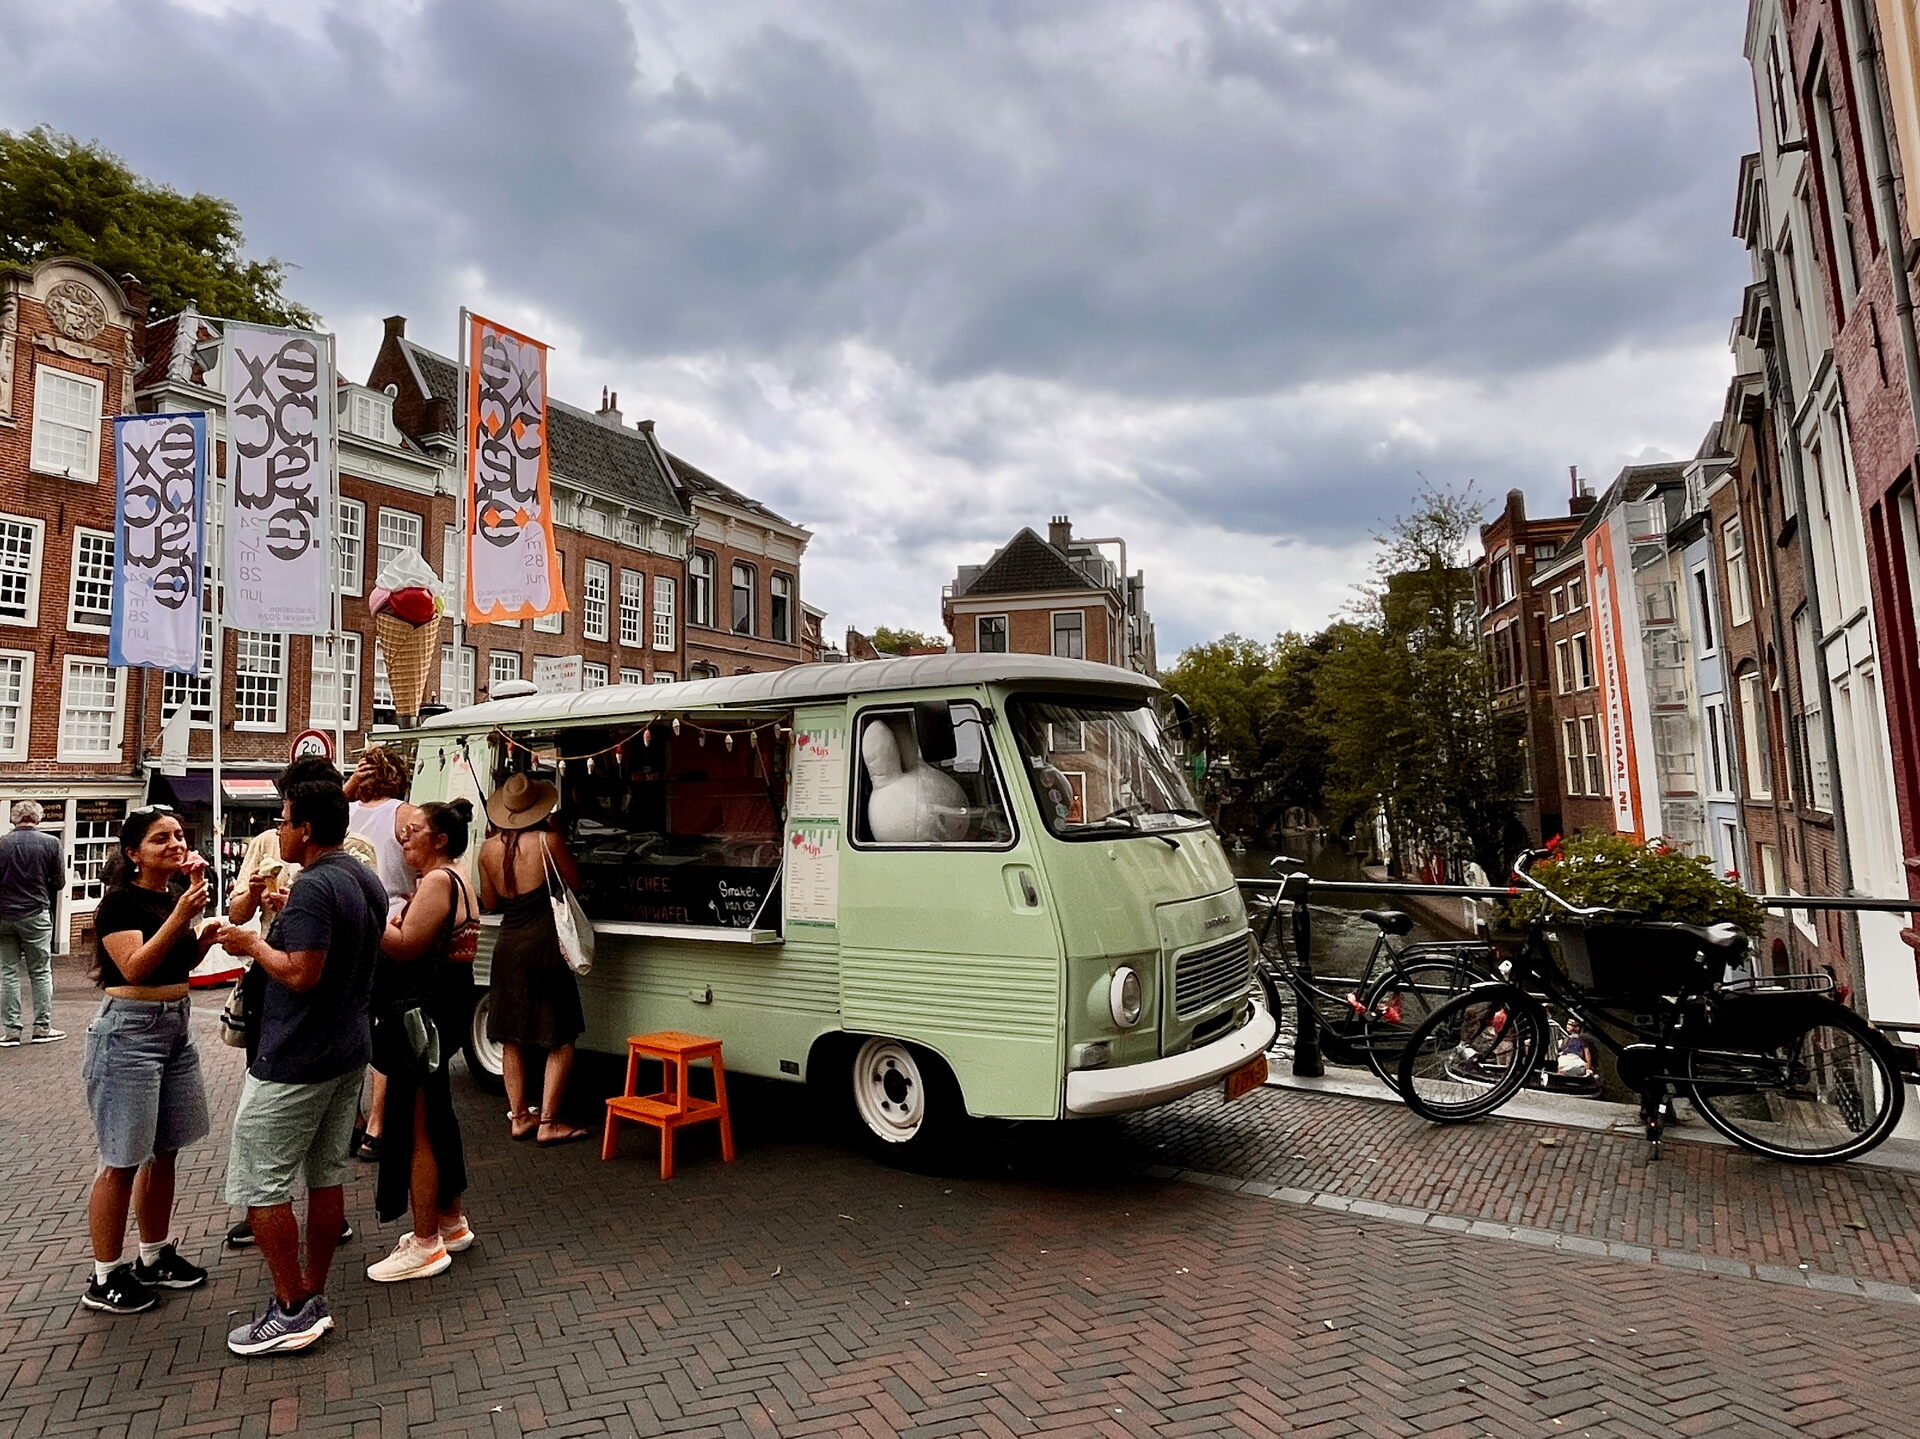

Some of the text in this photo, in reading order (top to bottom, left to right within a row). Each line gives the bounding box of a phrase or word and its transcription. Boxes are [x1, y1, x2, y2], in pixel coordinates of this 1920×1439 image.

[525, 554, 544, 568] 28
[525, 573, 546, 585] jun
[802, 843, 821, 856] Mijs
[719, 880, 760, 898] Smaken
[725, 899, 757, 911] van de
